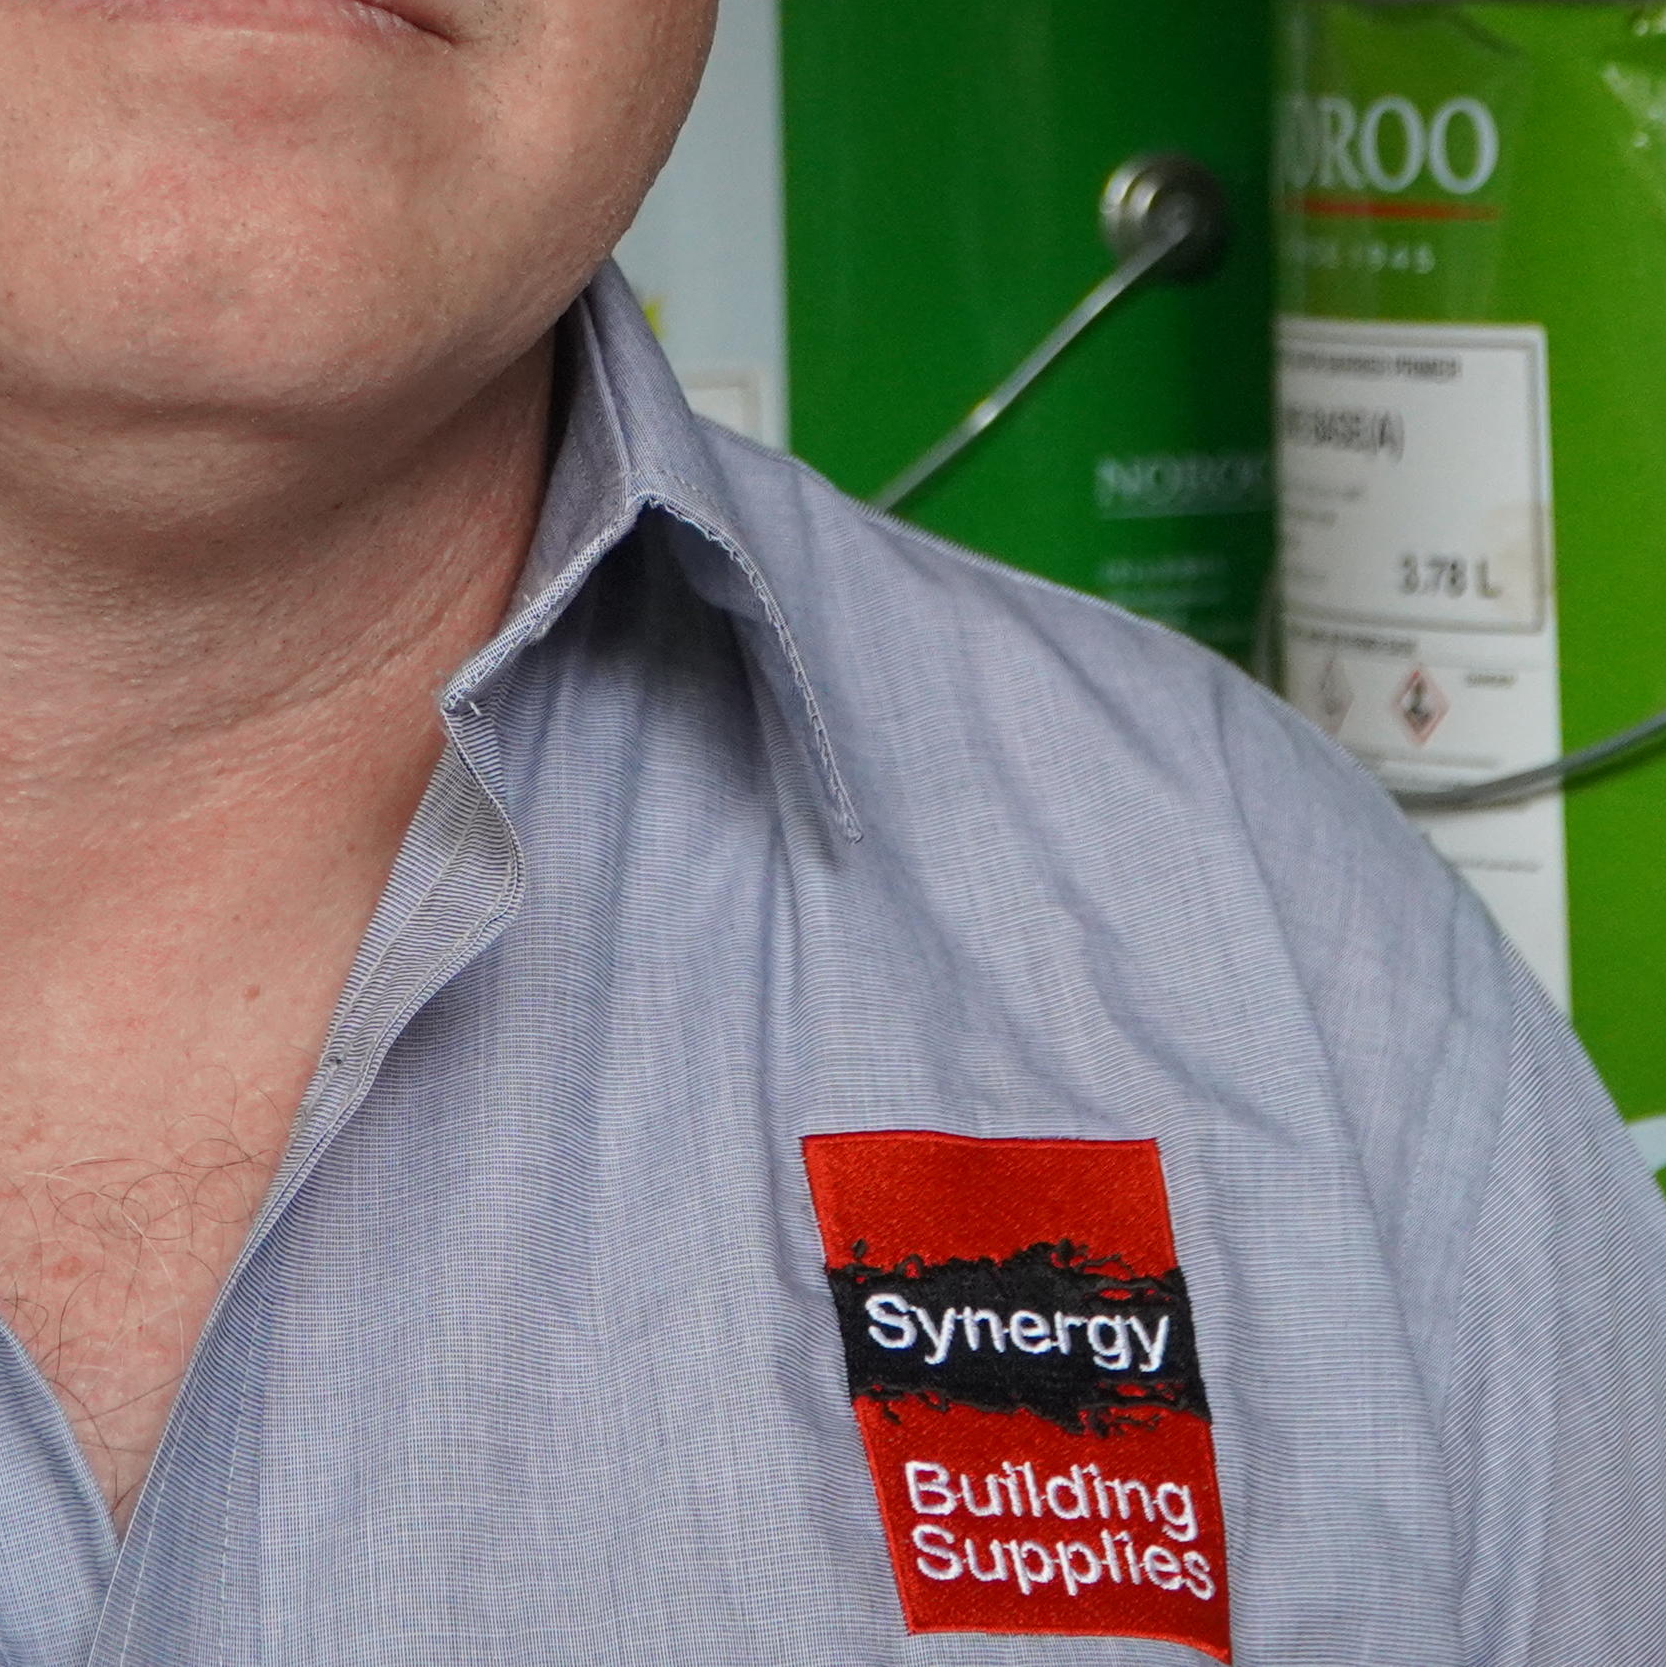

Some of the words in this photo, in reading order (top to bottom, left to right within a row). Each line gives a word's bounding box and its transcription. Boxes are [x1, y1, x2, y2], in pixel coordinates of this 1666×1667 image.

[1399, 554, 1468, 600] 3.78
[1477, 559, 1503, 600] L
[863, 1293, 1171, 1372] Synergy
[904, 1459, 1201, 1542] Building
[911, 1523, 1216, 1602] Supplies
